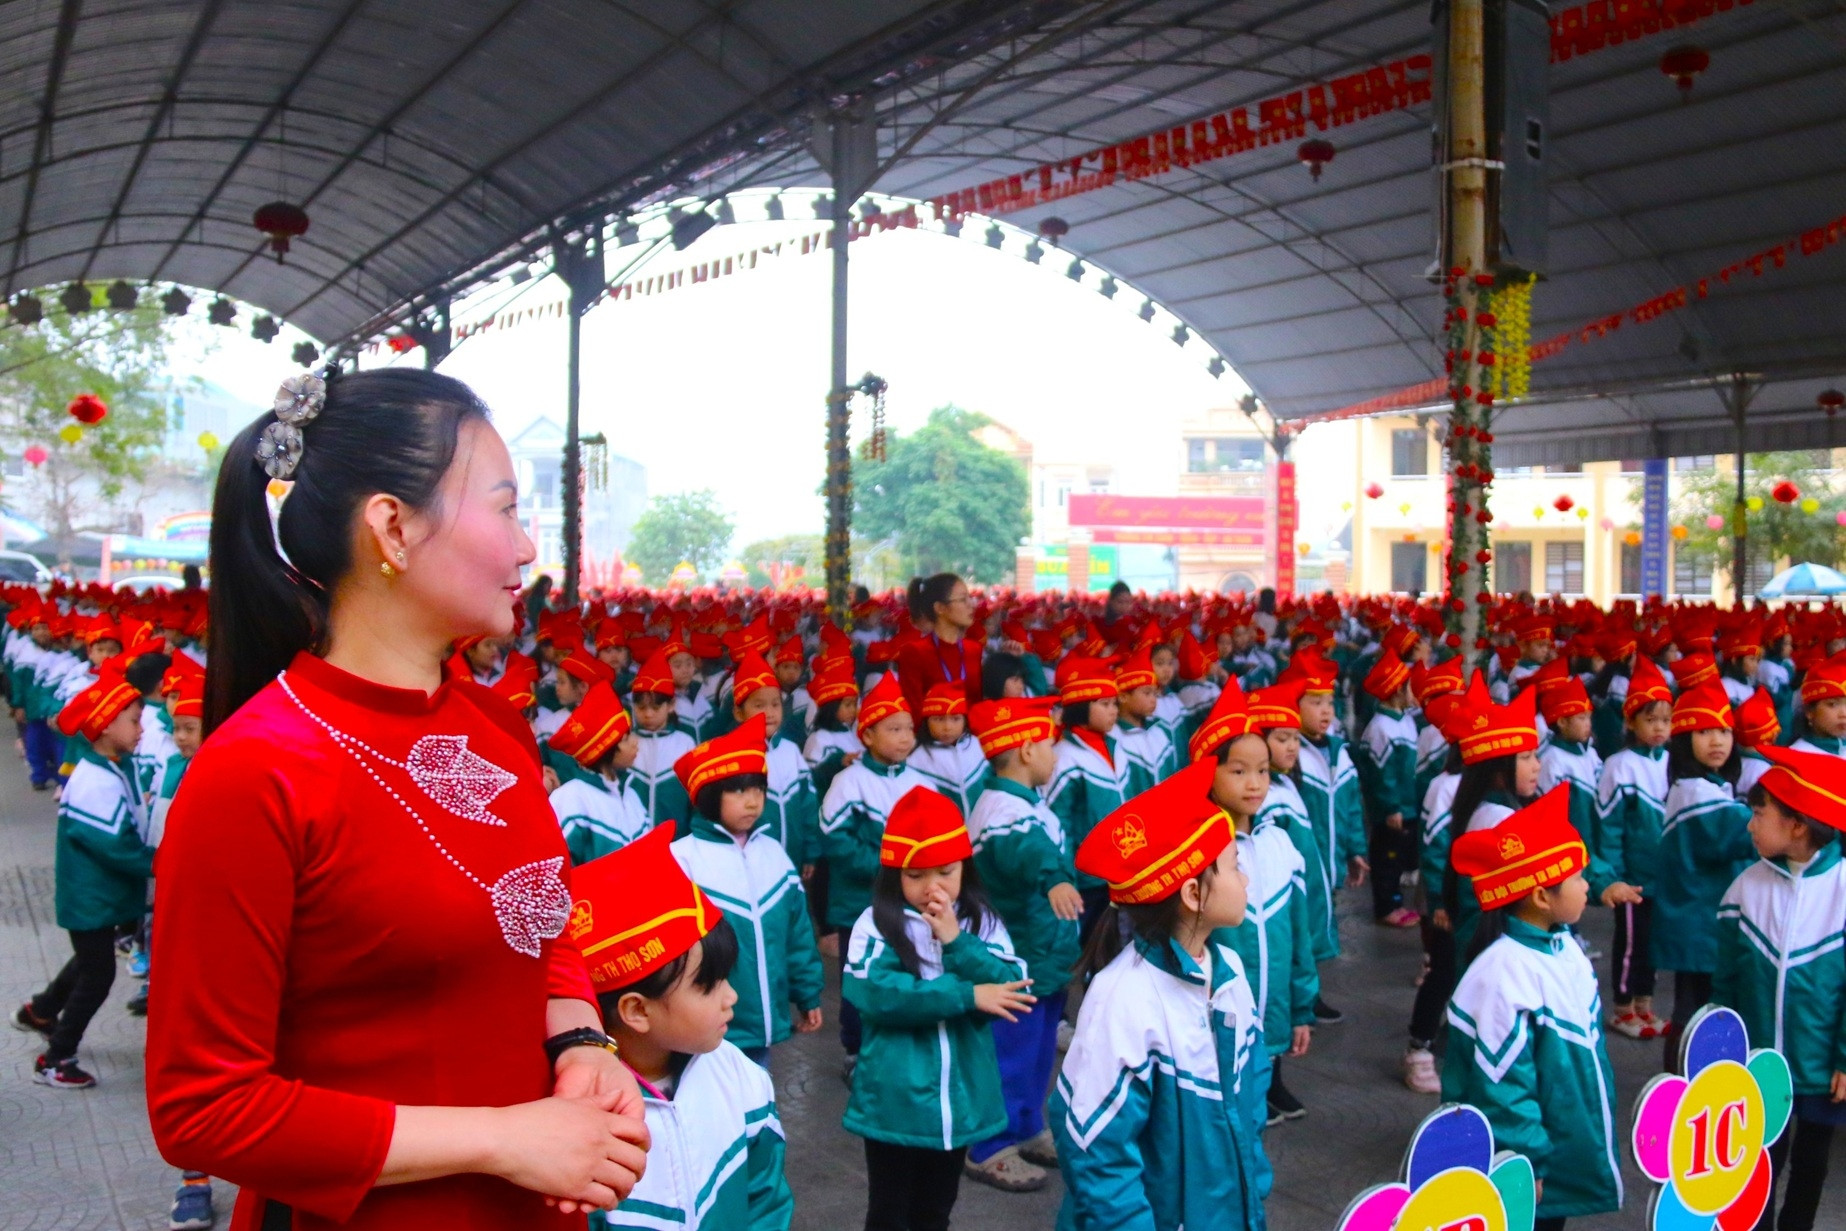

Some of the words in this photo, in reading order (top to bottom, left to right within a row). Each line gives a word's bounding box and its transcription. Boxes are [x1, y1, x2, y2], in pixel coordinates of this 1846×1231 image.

[602, 960, 620, 978] TH
[617, 951, 643, 972] THỌ
[1685, 1098, 1746, 1179] 1C
